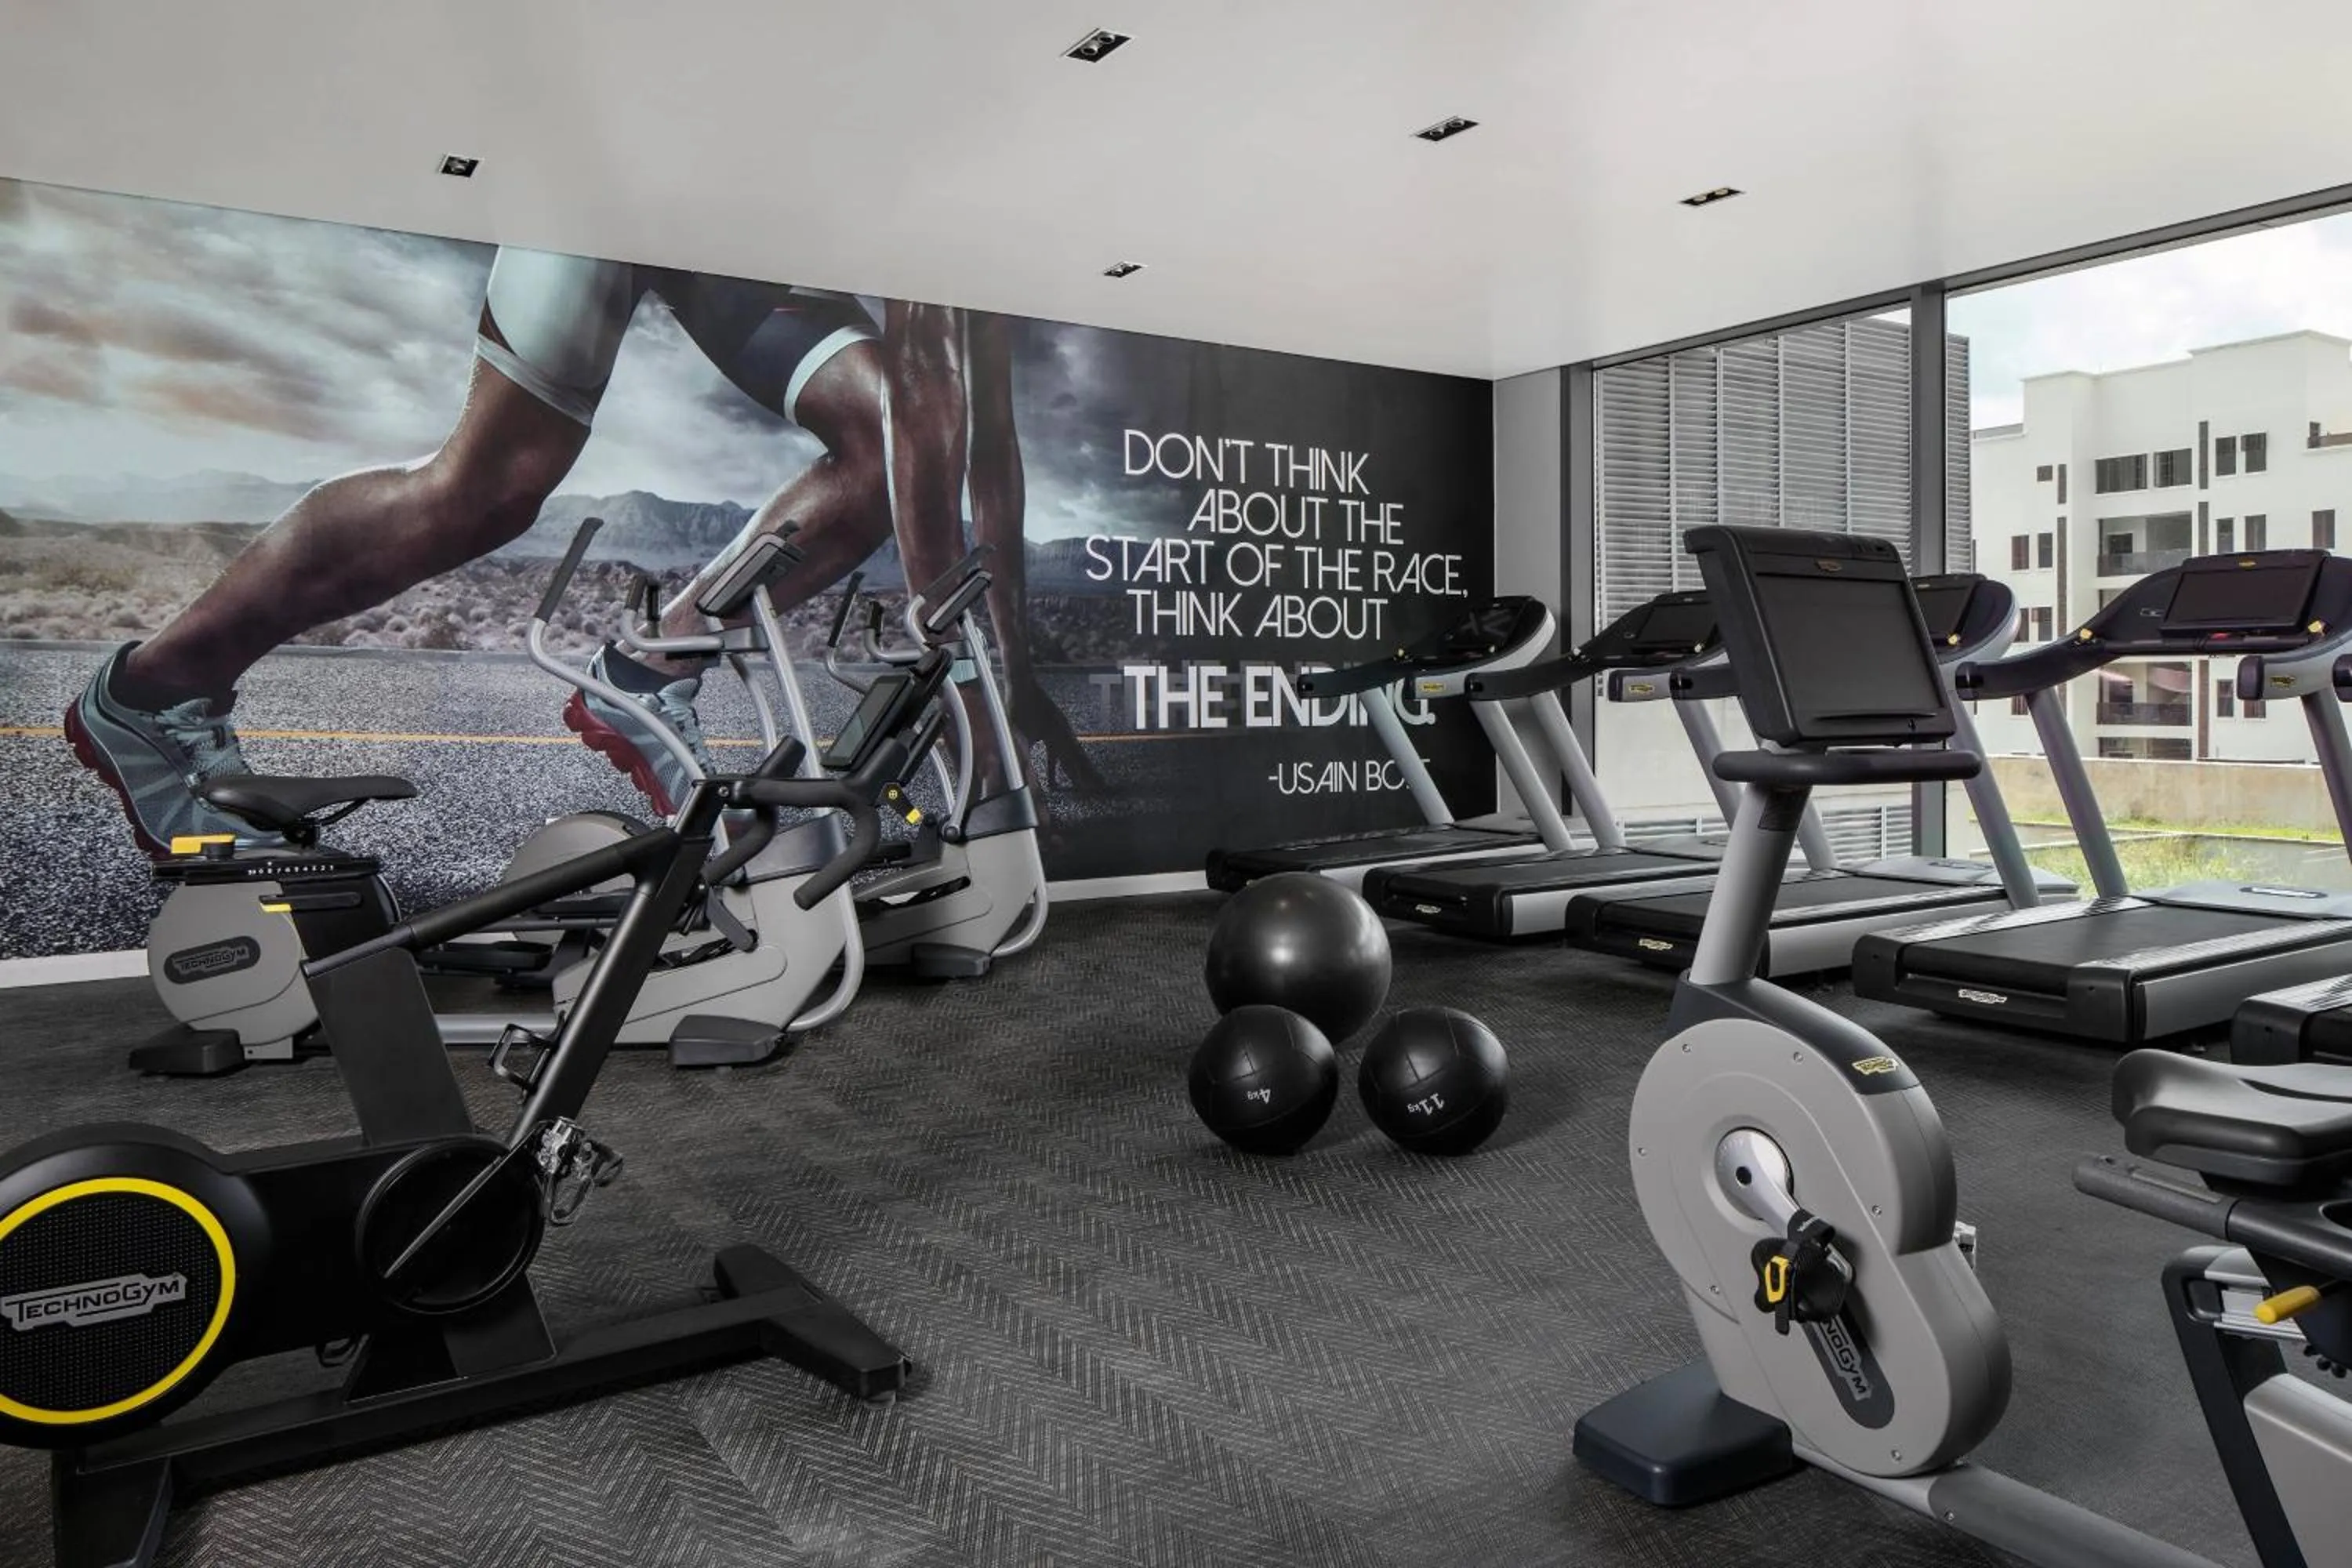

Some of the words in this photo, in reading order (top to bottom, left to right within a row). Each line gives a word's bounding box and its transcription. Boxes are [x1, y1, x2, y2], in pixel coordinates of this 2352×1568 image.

[1124, 429, 1254, 484] DON'T
[1265, 443, 1370, 495] THINK
[1188, 488, 1329, 540] ABOUT
[1338, 498, 1405, 545] THE
[1085, 534, 1215, 585] START
[1226, 542, 1285, 587] OF
[1294, 546, 1363, 592] THE
[1373, 551, 1468, 597] RACE,
[1126, 589, 1243, 637] THINK
[1254, 595, 1388, 641] ABOUT
[1123, 665, 1229, 730] THE
[1365, 758, 1431, 792] BO
[1247, 1088, 1272, 1104] 4kg
[1406, 1092, 1445, 1116] 11kg
[1819, 1316, 1867, 1394] NOGYM
